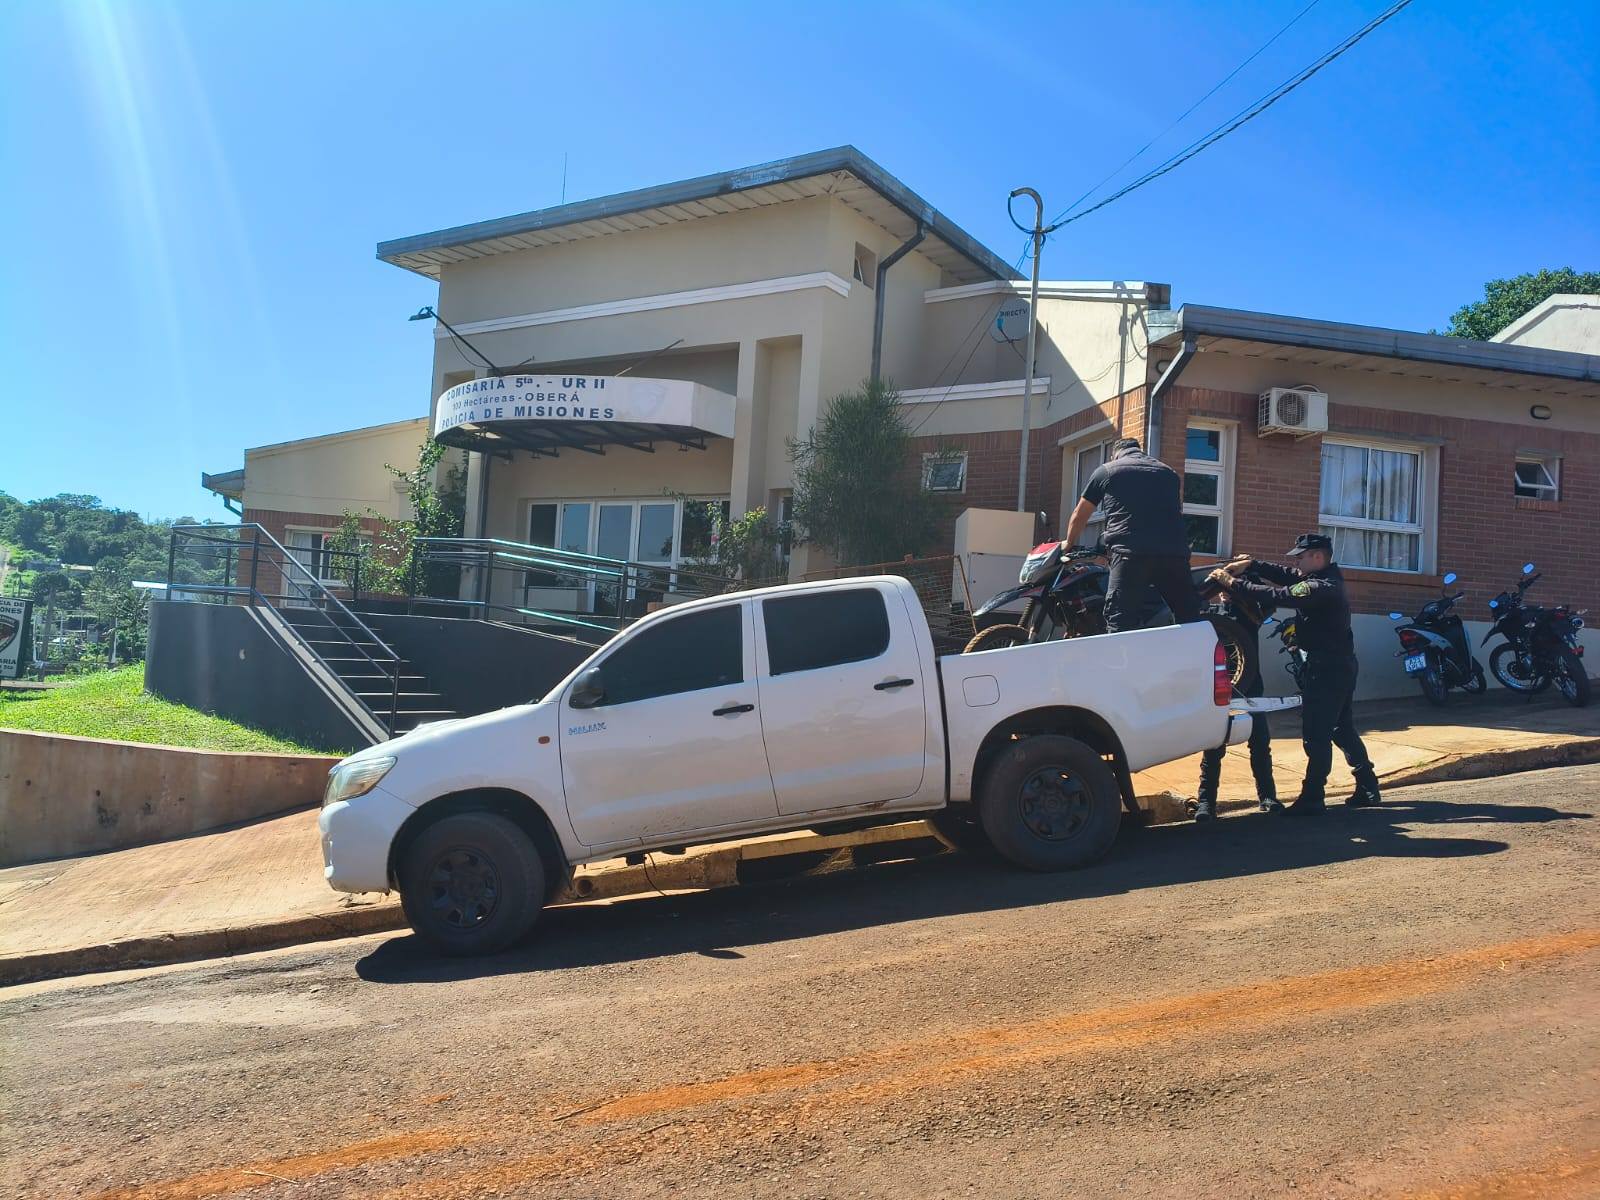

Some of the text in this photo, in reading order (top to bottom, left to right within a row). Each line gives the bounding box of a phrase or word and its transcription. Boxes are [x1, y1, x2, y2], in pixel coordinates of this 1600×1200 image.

[447, 379, 505, 401] COMISARIA
[562, 377, 586, 389] UR
[441, 406, 614, 430] POLICIA DE MISIONES
